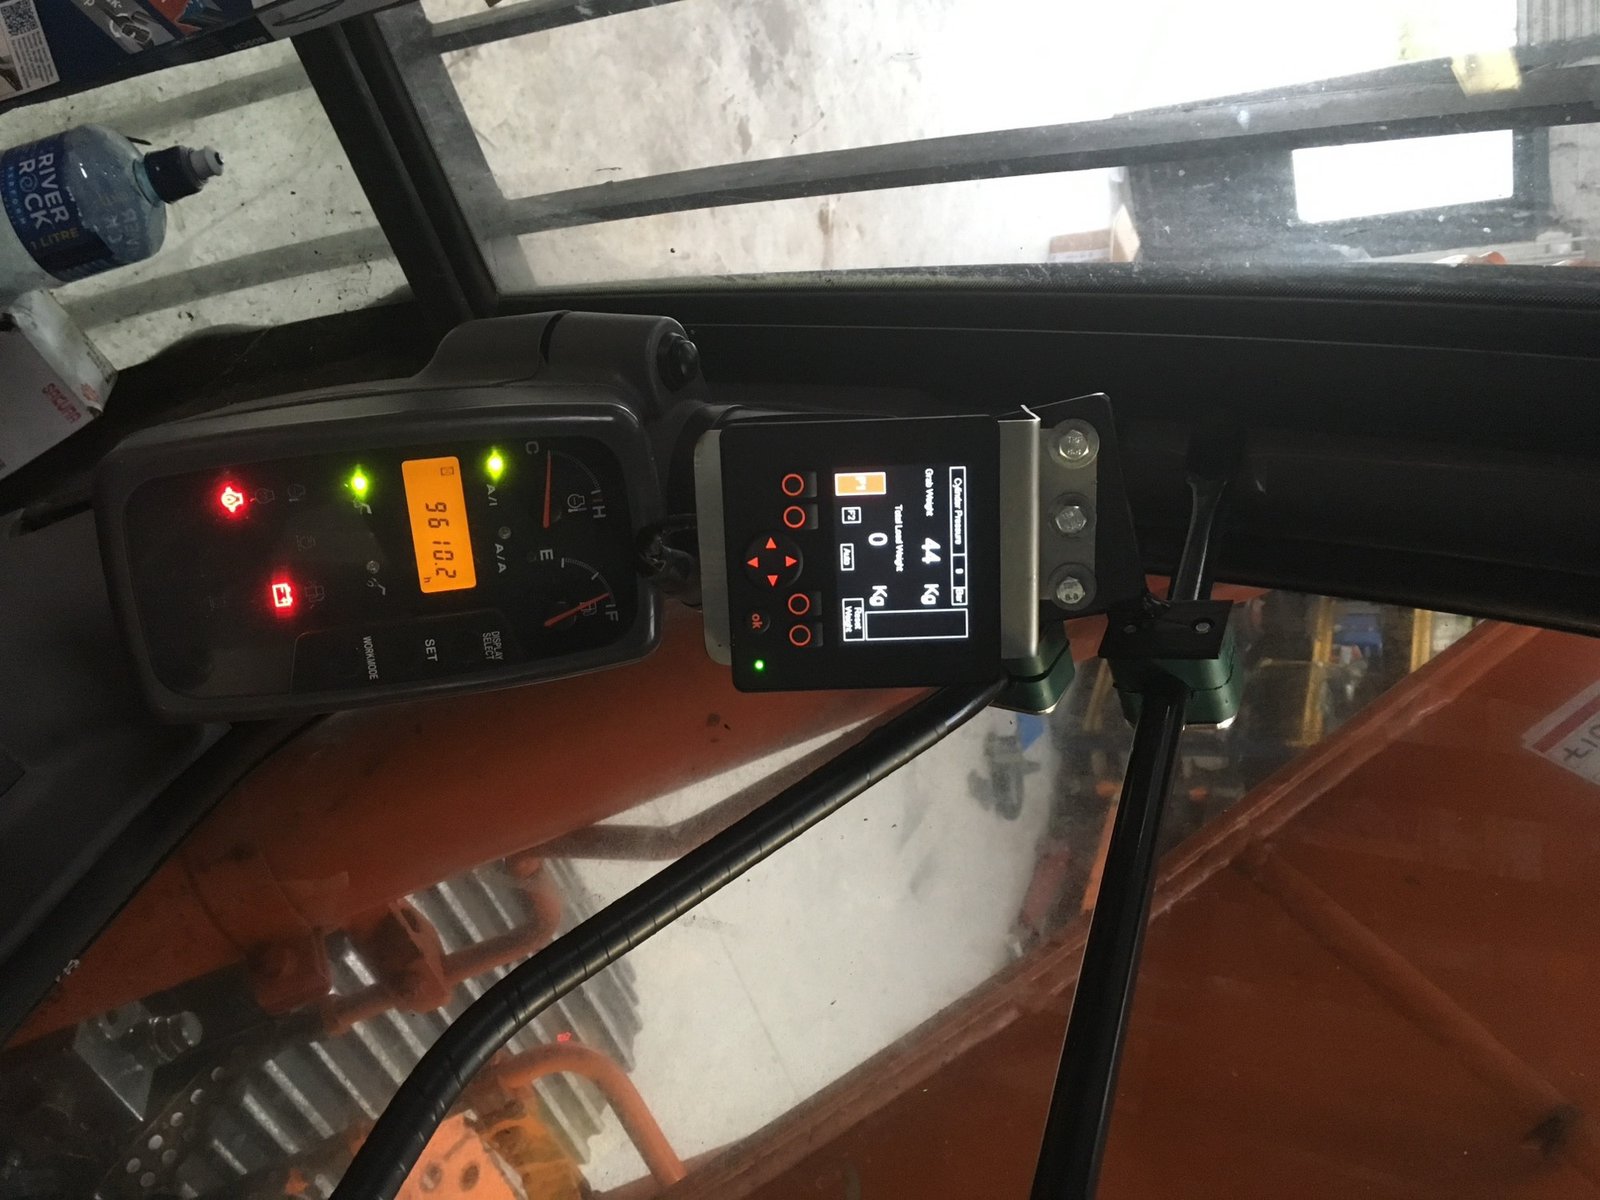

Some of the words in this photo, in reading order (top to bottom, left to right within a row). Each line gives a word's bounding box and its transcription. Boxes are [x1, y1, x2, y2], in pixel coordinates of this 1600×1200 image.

[19, 158, 53, 230] ROCK
[38, 152, 70, 223] RIVER
[40, 227, 80, 248] LITRE
[525, 441, 539, 455] C
[924, 468, 934, 488] Grab
[924, 488, 934, 517] Weight
[952, 477, 963, 509] Cylinder
[592, 505, 607, 518] H
[894, 504, 903, 525] Total
[868, 532, 888, 546] 0
[894, 525, 903, 544] Load
[954, 510, 964, 545] Pressure
[425, 501, 457, 579] 9610.2
[921, 537, 941, 564] 44
[494, 543, 508, 574] A/A
[540, 549, 554, 561] E
[843, 548, 851, 566] Auto
[894, 544, 904, 572] Weight
[869, 585, 888, 606] Kg
[920, 584, 939, 605] Kg
[955, 588, 964, 602] Bar
[605, 610, 619, 622] F
[751, 613, 763, 629] ok
[844, 606, 852, 632] Weight
[854, 607, 862, 630] Reset
[424, 638, 438, 662] SET
[482, 632, 495, 660] SELECT
[491, 630, 503, 660] DISPLAY
[362, 635, 379, 680] WORKMODE
